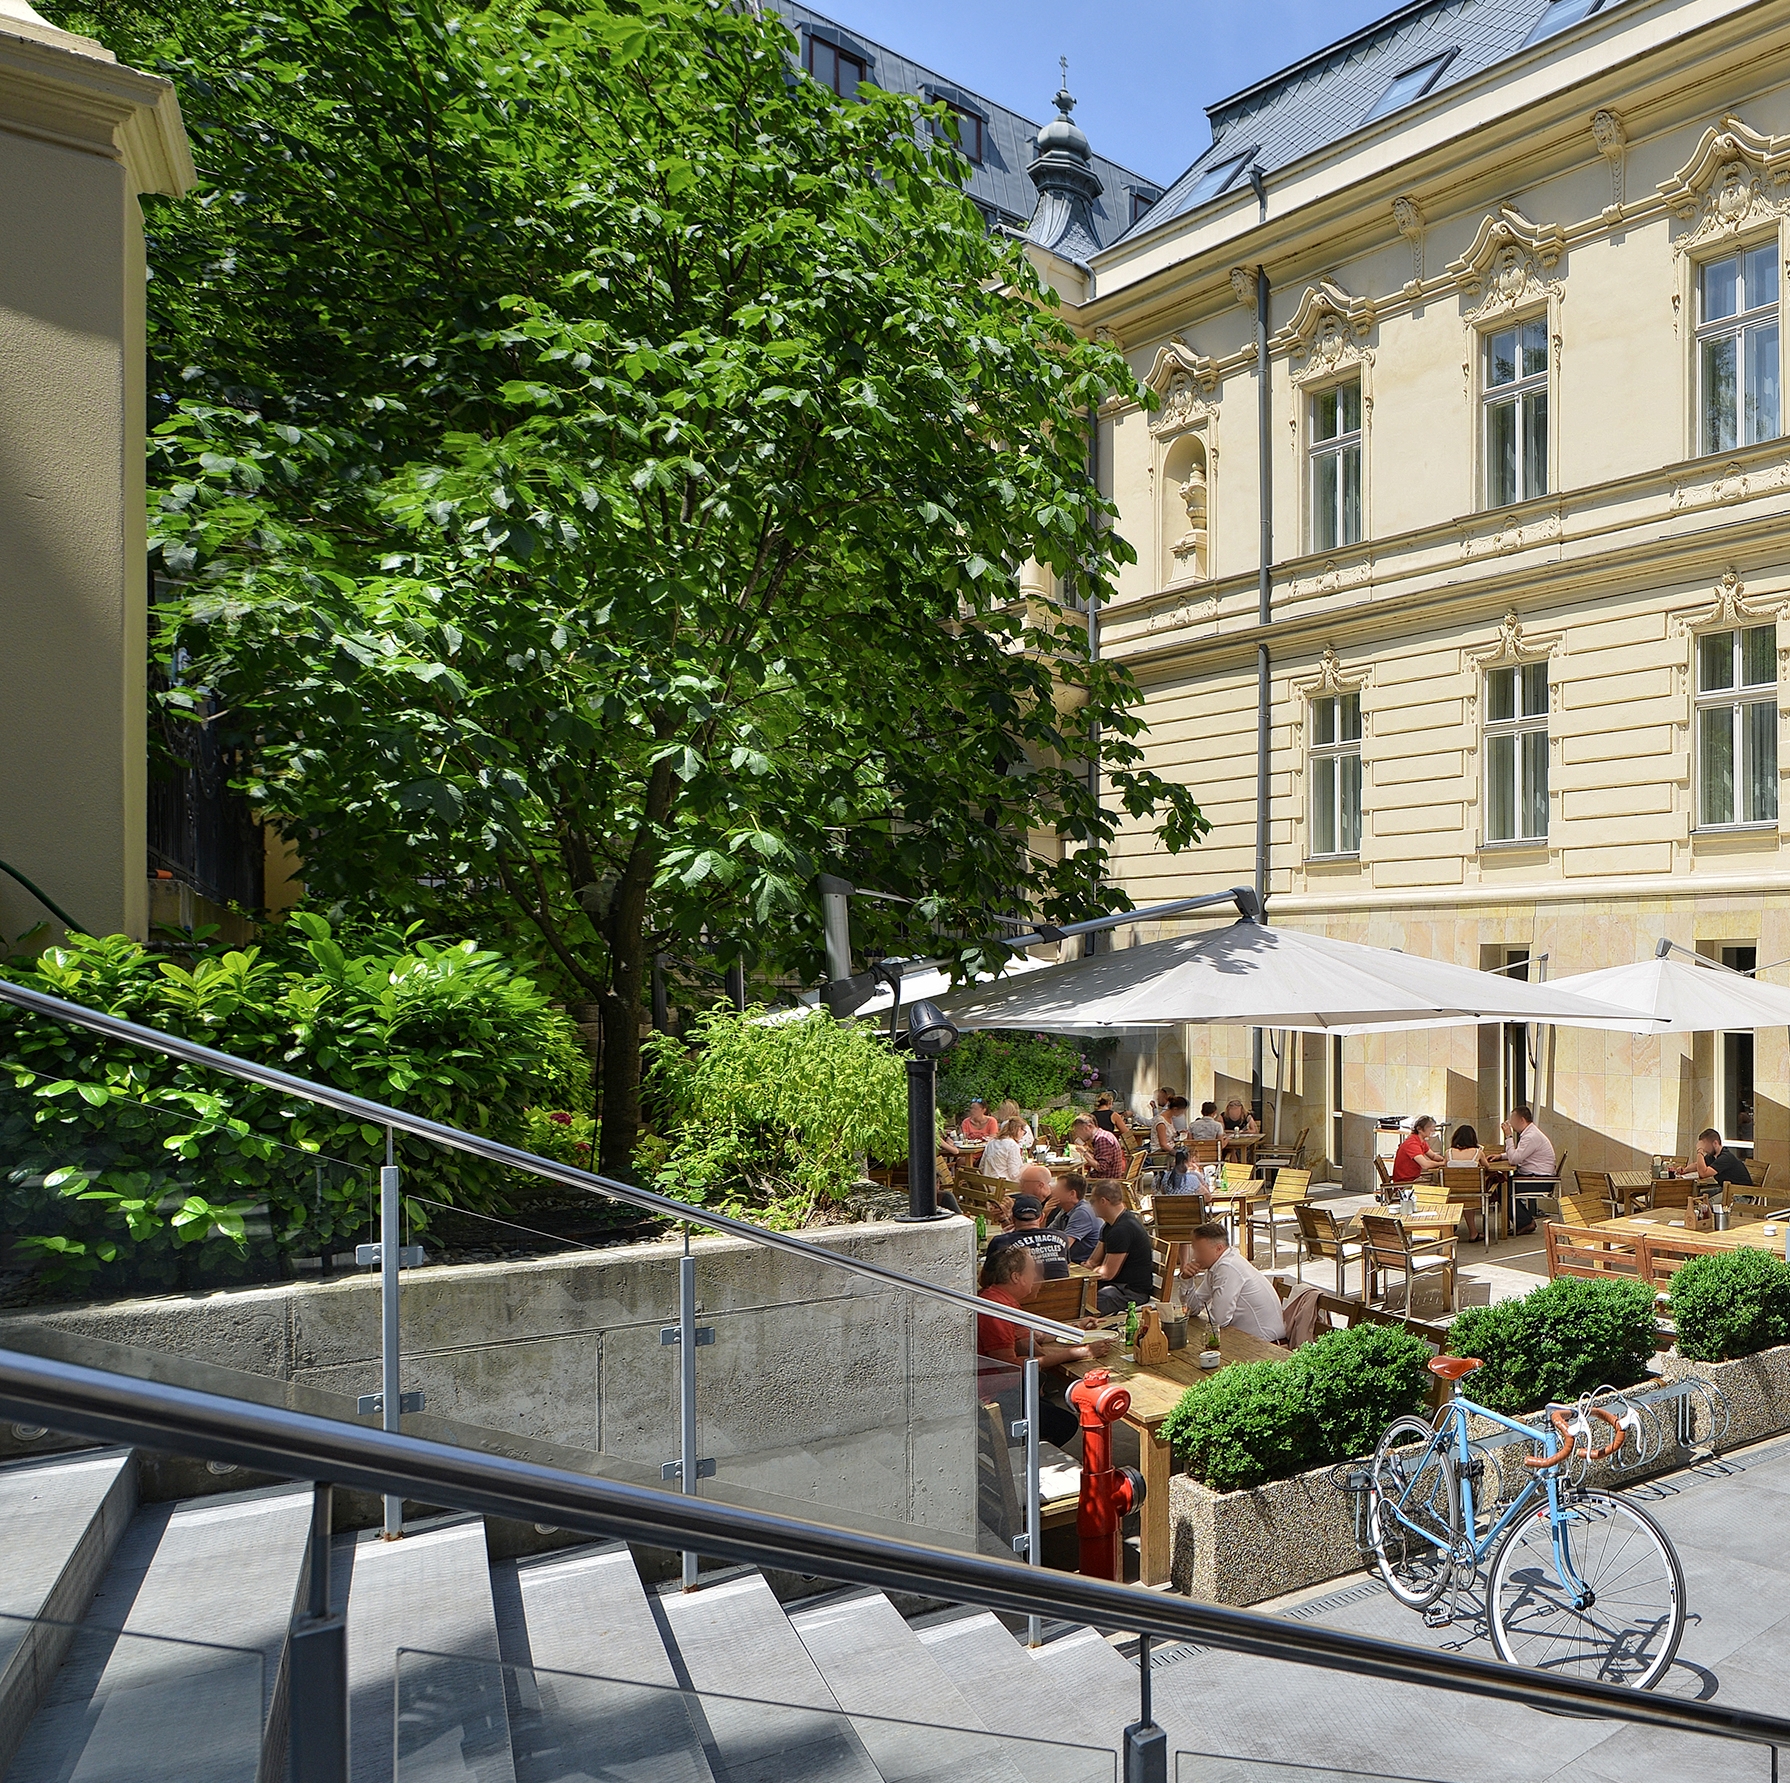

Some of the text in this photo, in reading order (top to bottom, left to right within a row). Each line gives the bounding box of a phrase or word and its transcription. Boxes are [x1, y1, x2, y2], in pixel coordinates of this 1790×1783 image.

[1023, 1235, 1035, 1246] EX
[1034, 1234, 1067, 1249] MACHINA
[1029, 1245, 1062, 1255] ORCYCLES
